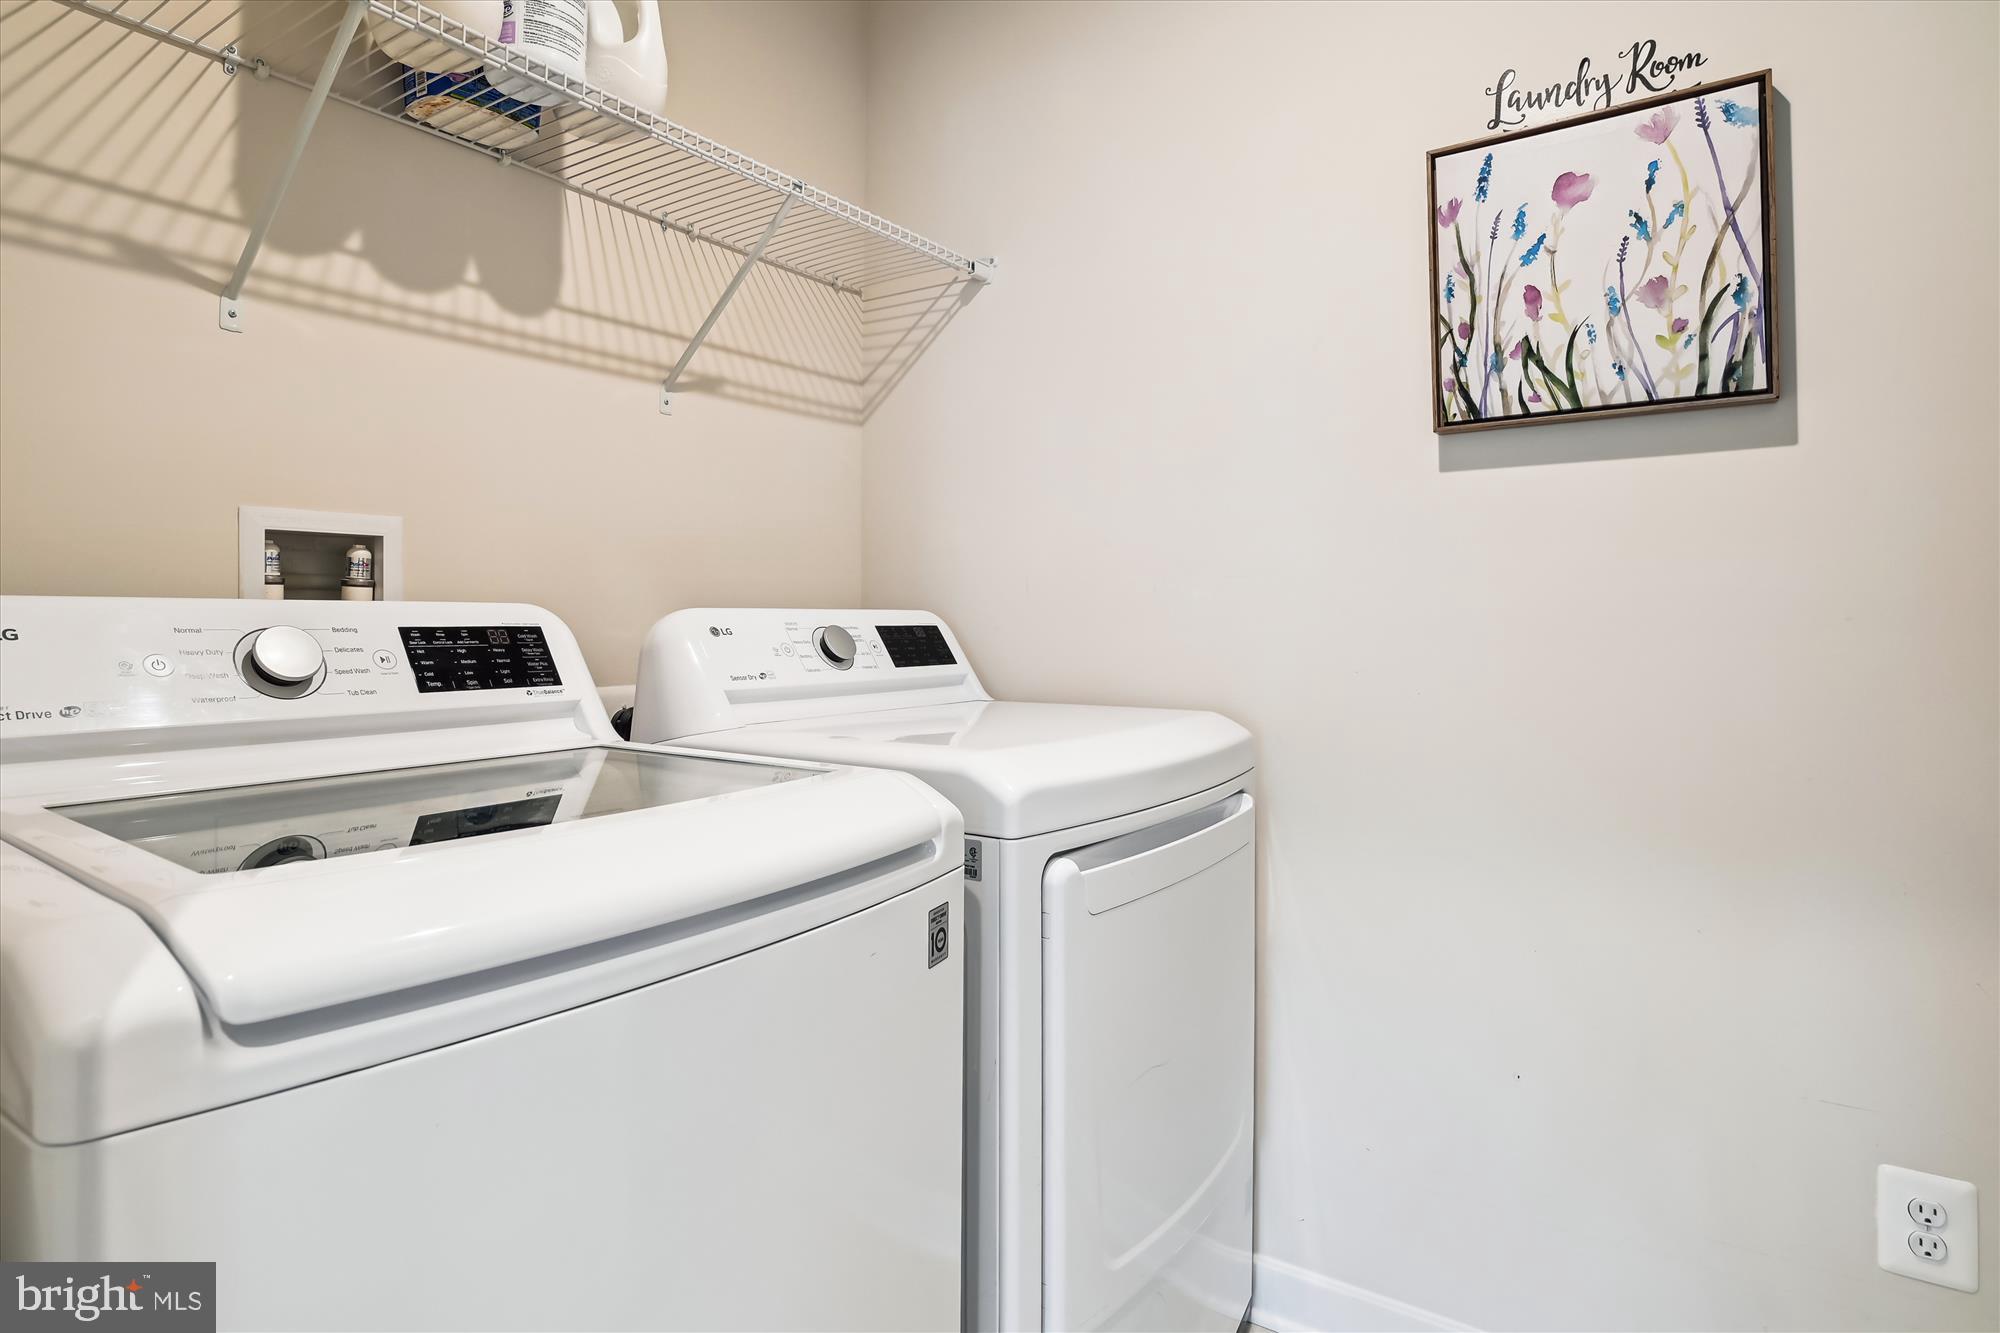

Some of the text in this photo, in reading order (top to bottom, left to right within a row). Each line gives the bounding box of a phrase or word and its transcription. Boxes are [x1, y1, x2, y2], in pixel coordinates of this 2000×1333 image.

[1485, 39, 1708, 130] Laundry Room
[205, 648, 224, 656] Duty
[191, 695, 236, 704] Waterproof
[15, 710, 52, 720] Drive
